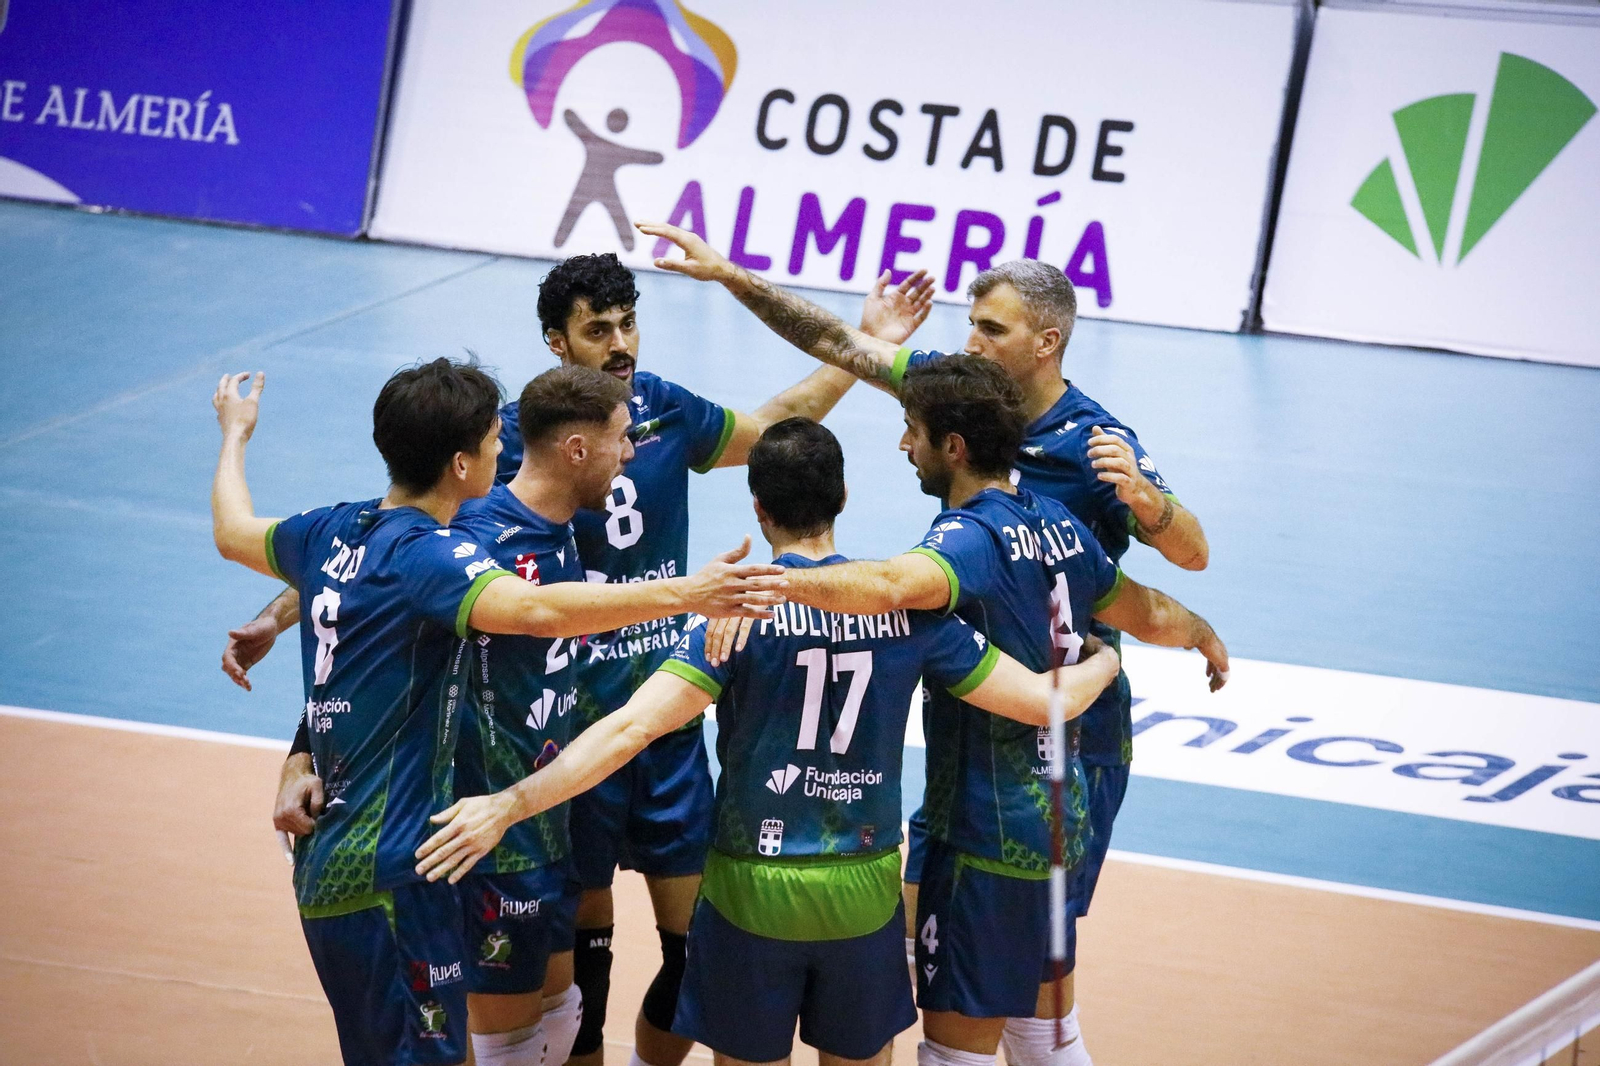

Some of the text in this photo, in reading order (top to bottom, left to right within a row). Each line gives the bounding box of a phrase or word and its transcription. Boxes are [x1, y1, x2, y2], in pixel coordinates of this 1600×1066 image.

[0, 79, 240, 146] E ALMERÍA
[755, 88, 1135, 183] COSTA DE
[651, 180, 1113, 308] ALMERÍA
[605, 474, 643, 550] 8
[605, 627, 680, 661] ALMERÍA
[795, 647, 873, 755] 17
[805, 766, 882, 785] Fundación
[1131, 697, 1600, 804] nicaj
[803, 781, 862, 805] Unicaja
[500, 897, 541, 917] kuver
[921, 914, 939, 954] 4
[429, 961, 462, 988] kuver
